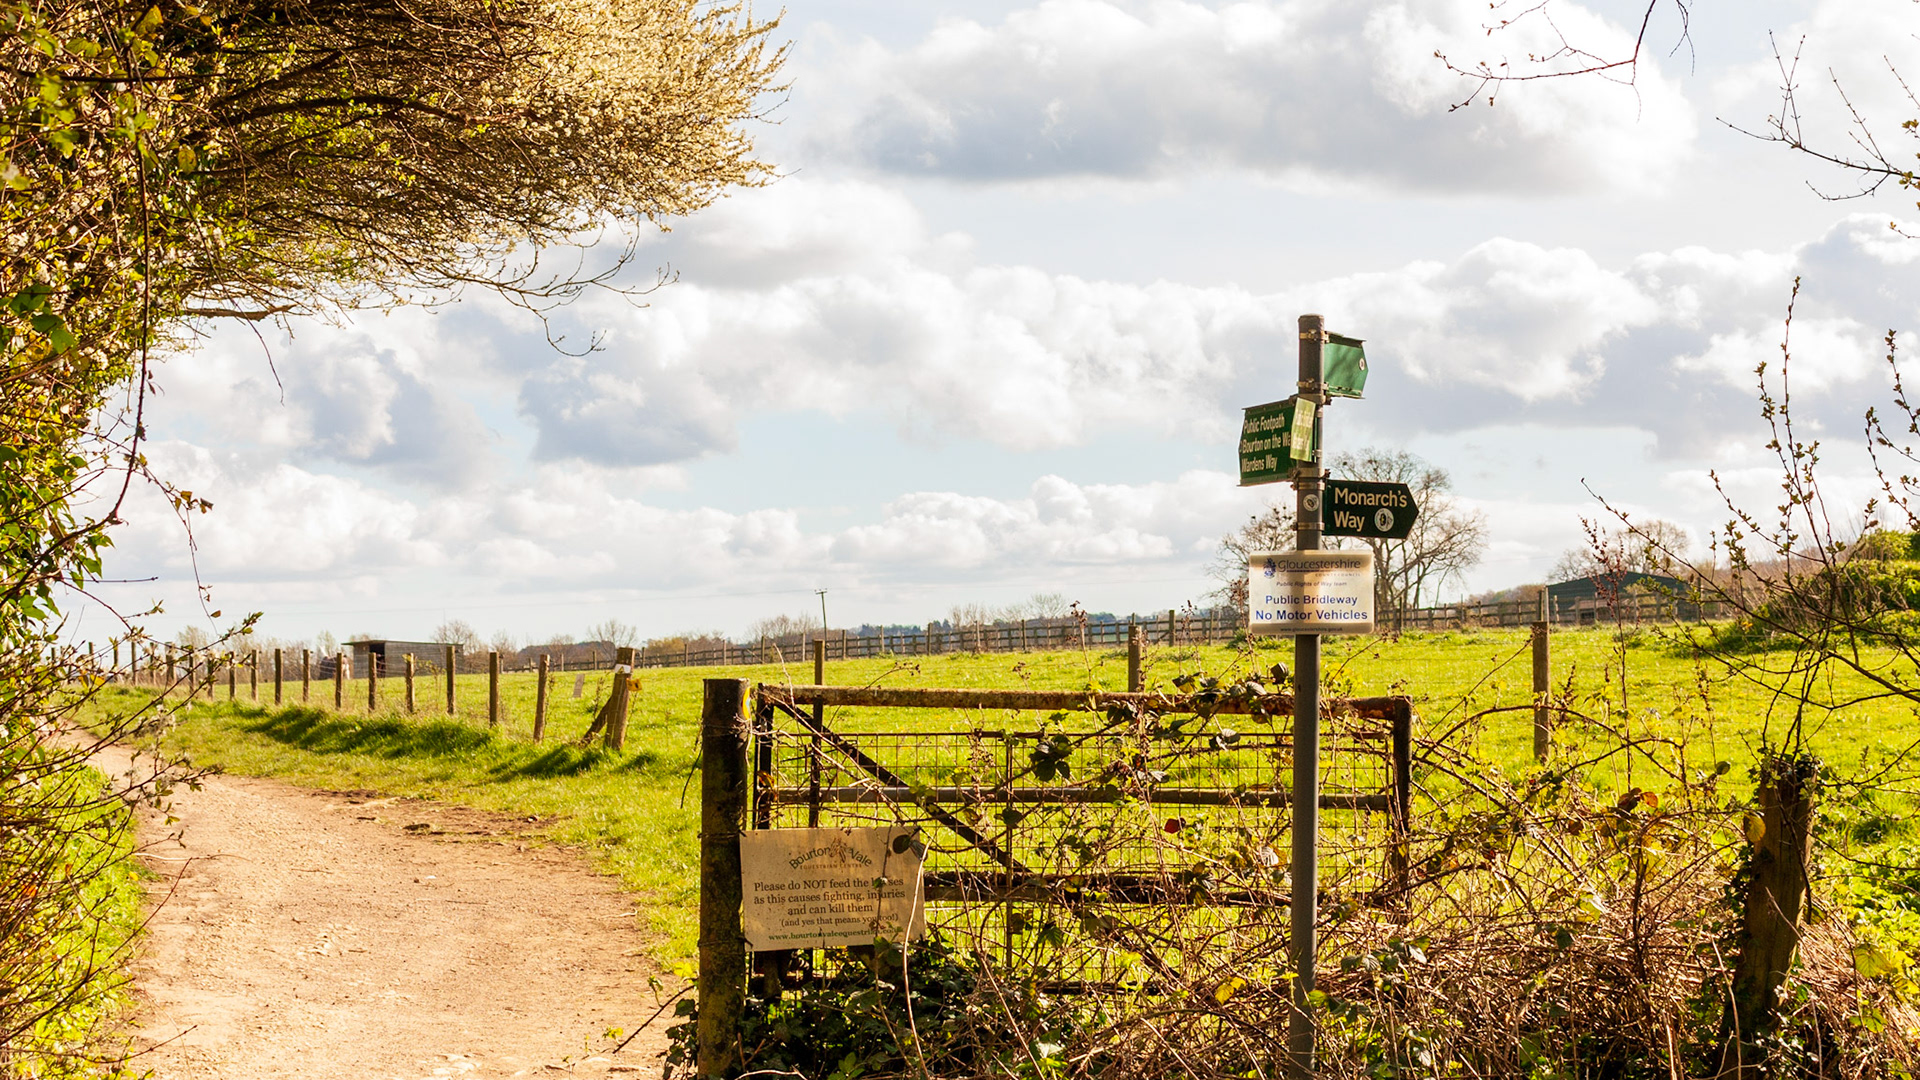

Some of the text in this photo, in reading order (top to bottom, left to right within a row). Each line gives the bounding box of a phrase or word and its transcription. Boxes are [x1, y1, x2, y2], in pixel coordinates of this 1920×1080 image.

[1244, 413, 1285, 433] Public Footpath
[1242, 437, 1264, 454] Bourton
[1264, 439, 1272, 450] on
[1272, 433, 1282, 449] the
[1242, 454, 1278, 473] Wardens Way
[1334, 487, 1408, 508] Monarch's
[1333, 510, 1365, 532] Way
[1265, 595, 1358, 606] Public Bridleway
[1255, 609, 1368, 620] No Motor Vehicles
[788, 846, 873, 870] Bourton Vale
[754, 882, 786, 892] Please
[788, 881, 801, 891] do
[803, 880, 827, 889] NOT
[829, 878, 851, 888] feed
[853, 877, 869, 887] the
[754, 889, 906, 905] as this causes fighting, injuries
[788, 902, 873, 916] and can kill them
[781, 918, 800, 927] (and
[801, 919, 815, 927] yes
[816, 917, 833, 925] that
[834, 915, 861, 925] means
[862, 915, 877, 925] you
